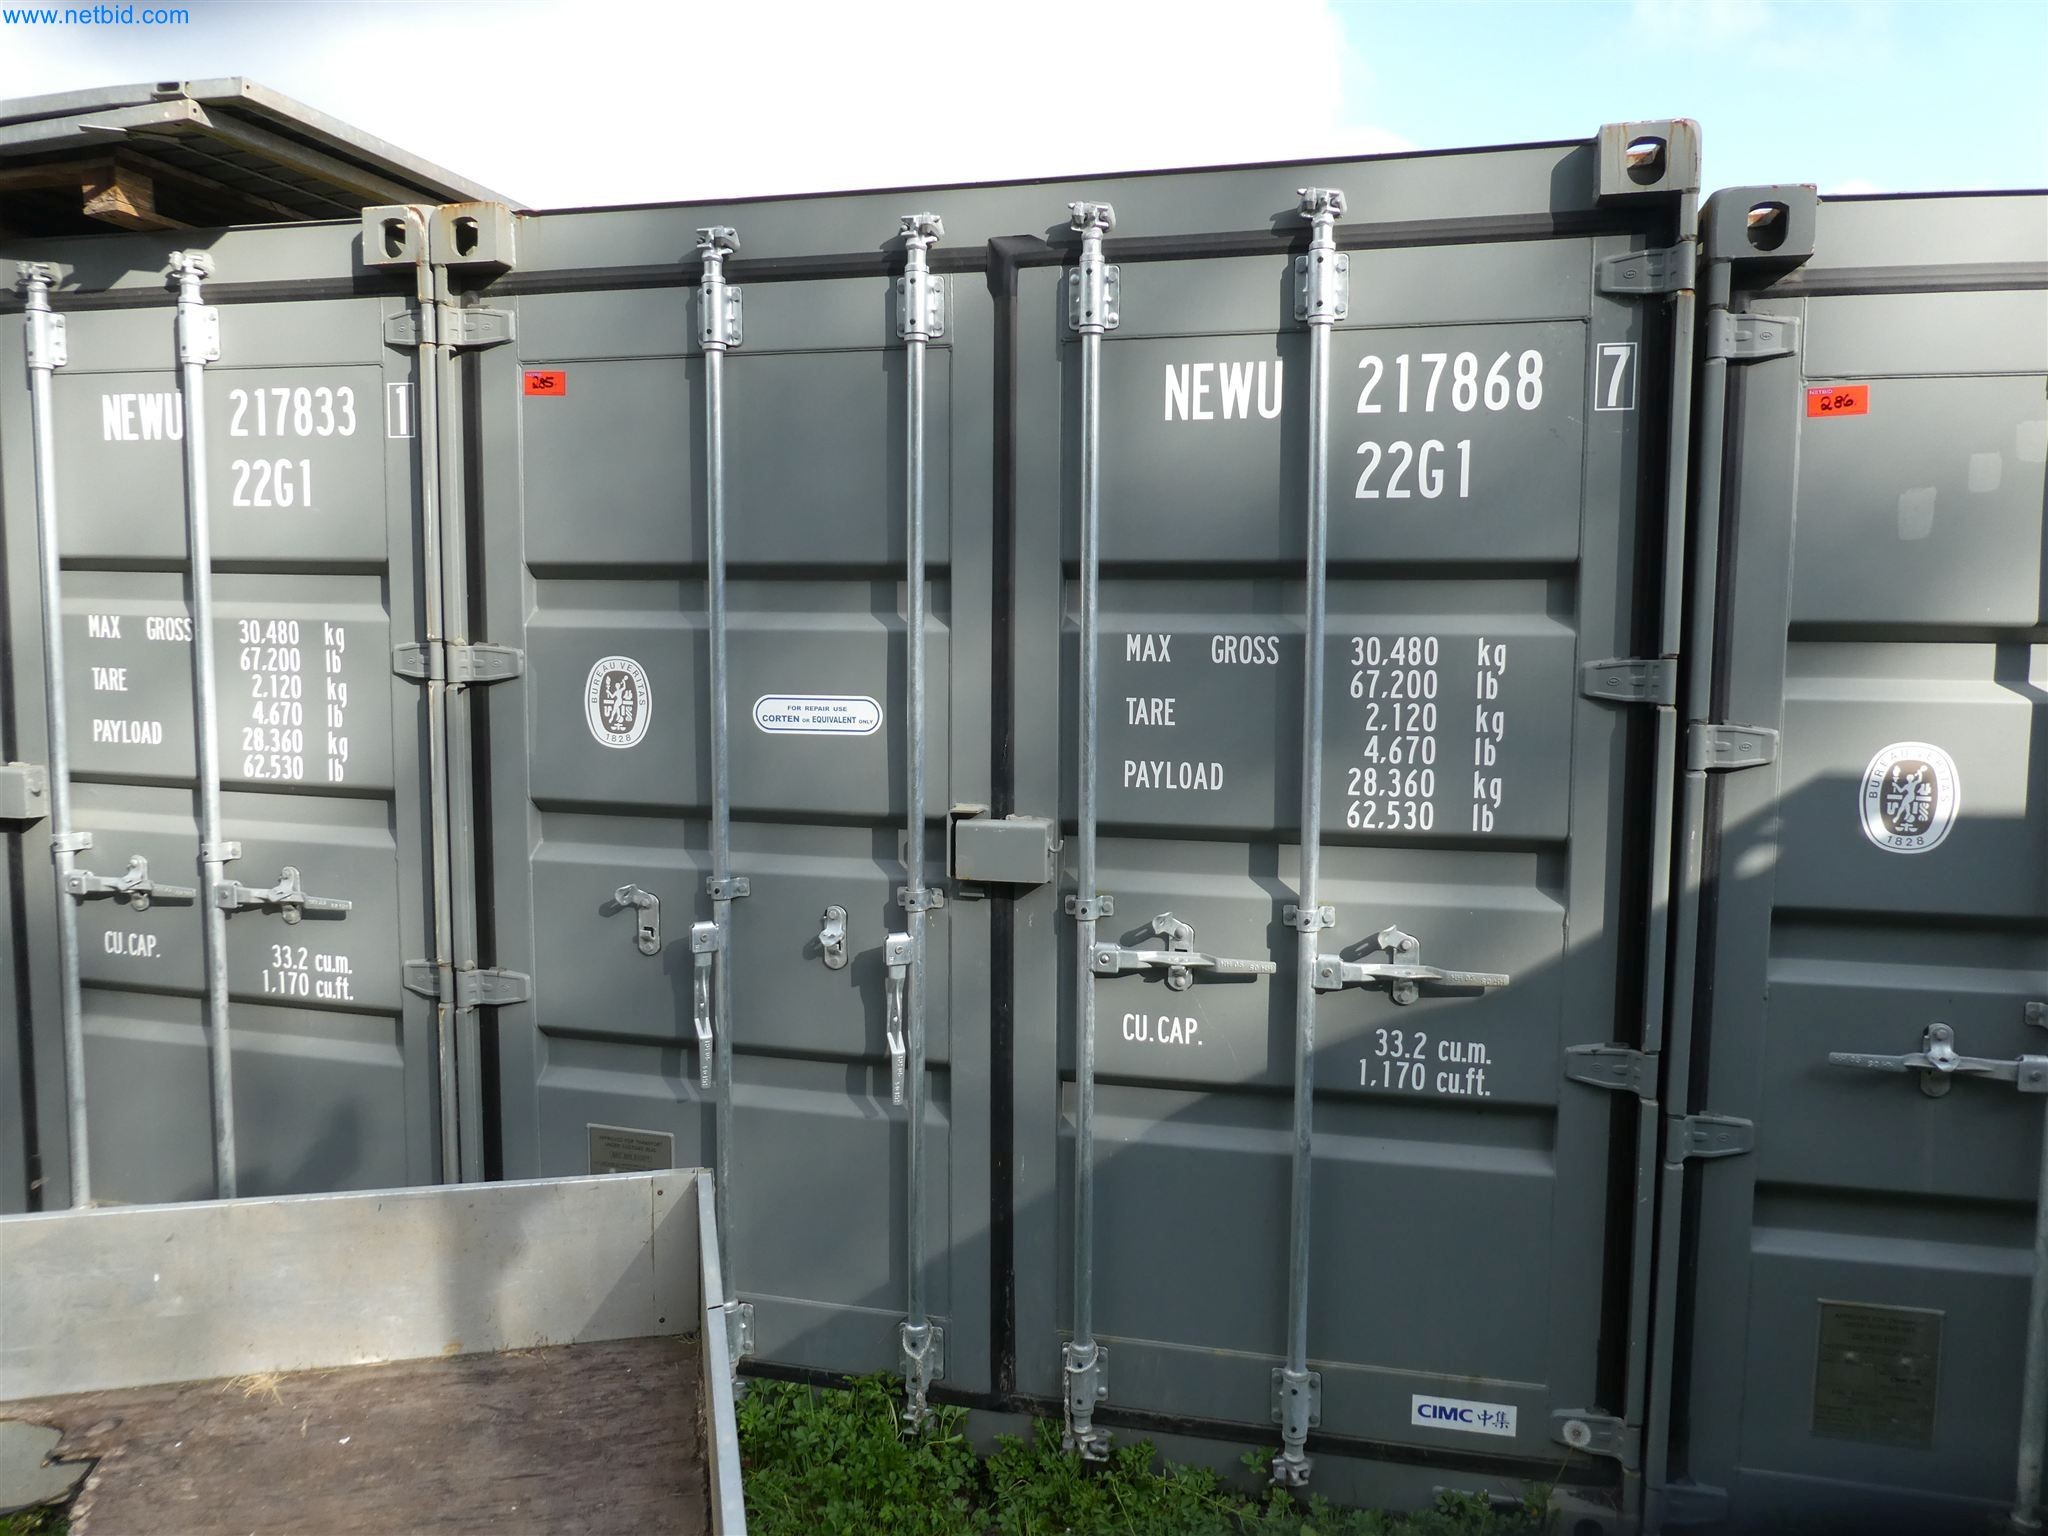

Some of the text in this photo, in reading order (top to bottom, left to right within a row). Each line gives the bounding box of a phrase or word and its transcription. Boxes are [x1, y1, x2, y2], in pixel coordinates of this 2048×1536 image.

[1164, 346, 1630, 421] NEWU 217868 7
[102, 385, 407, 441] NEWU 217833 1
[1820, 394, 1854, 411] 286
[231, 458, 311, 508] 22G1
[1355, 439, 1471, 499] 22G1
[88, 615, 121, 639] MAX
[146, 616, 193, 642] GROSS
[324, 622, 345, 653] kg
[325, 649, 342, 673] lb
[1126, 633, 1507, 675] MAX GROSS 30,480 kg
[91, 667, 128, 692] TARE
[327, 677, 347, 708] kg
[591, 661, 646, 706] BUREAU VERITAS
[1350, 669, 1498, 700] 67,200 lb
[328, 703, 343, 727] lb
[762, 714, 800, 723] CORTEN
[812, 715, 857, 724] EQUIVALENT
[1125, 697, 1505, 742] TARE 2,120 kg
[93, 719, 162, 745] PAYLOAD
[328, 731, 348, 763] kg
[606, 733, 631, 743] 1828
[1363, 735, 1496, 766] 4,670 lb
[328, 758, 344, 782] lb
[1124, 760, 1502, 808] PAYLOAD 28,360 kg
[1346, 800, 1494, 832] 62,530 lb
[1887, 836, 1925, 847] 1828
[104, 930, 353, 974] CU.CAP. 33.2 cu.m.
[316, 976, 354, 1001] cu.ft.
[1122, 1013, 1492, 1065] CU.CAP. 33.2 cu.m.
[1436, 1067, 1491, 1096] cu.ft.
[1417, 1403, 1511, 1429] CIMC 中集
